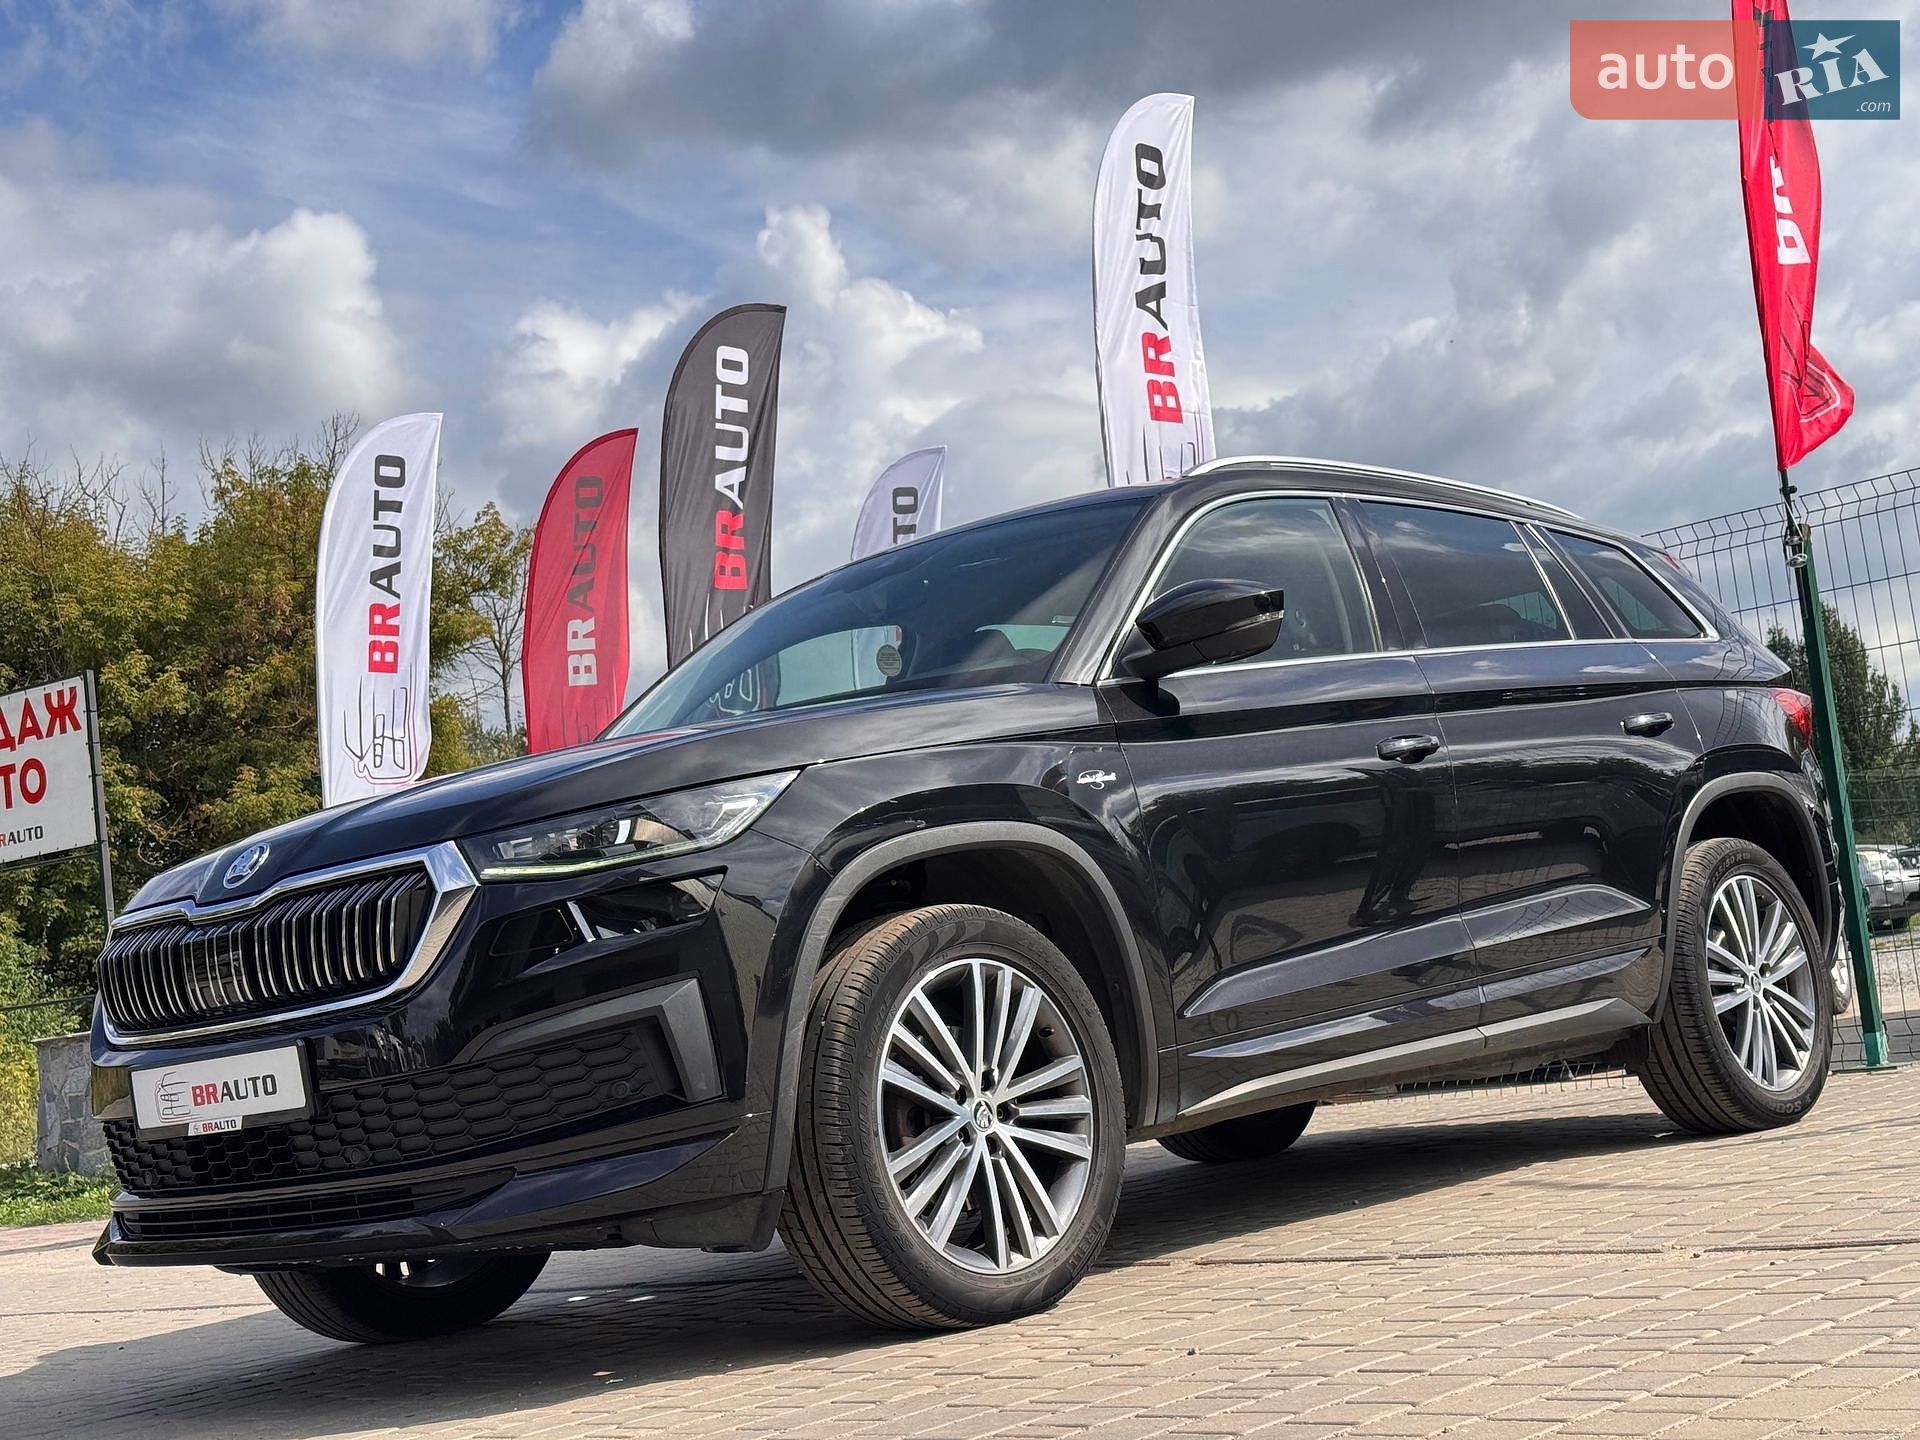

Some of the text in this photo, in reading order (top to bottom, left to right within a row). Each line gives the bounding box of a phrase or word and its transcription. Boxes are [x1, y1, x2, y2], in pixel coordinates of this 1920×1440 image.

[1135, 142, 1184, 425] BRAUTO
[367, 454, 408, 675] BRAUTO
[713, 345, 750, 591] BRAUTO
[566, 475, 605, 687] BRAUTO
[191, 1073, 278, 1108] BRAUTO
[202, 1119, 237, 1133] BRAUTO
